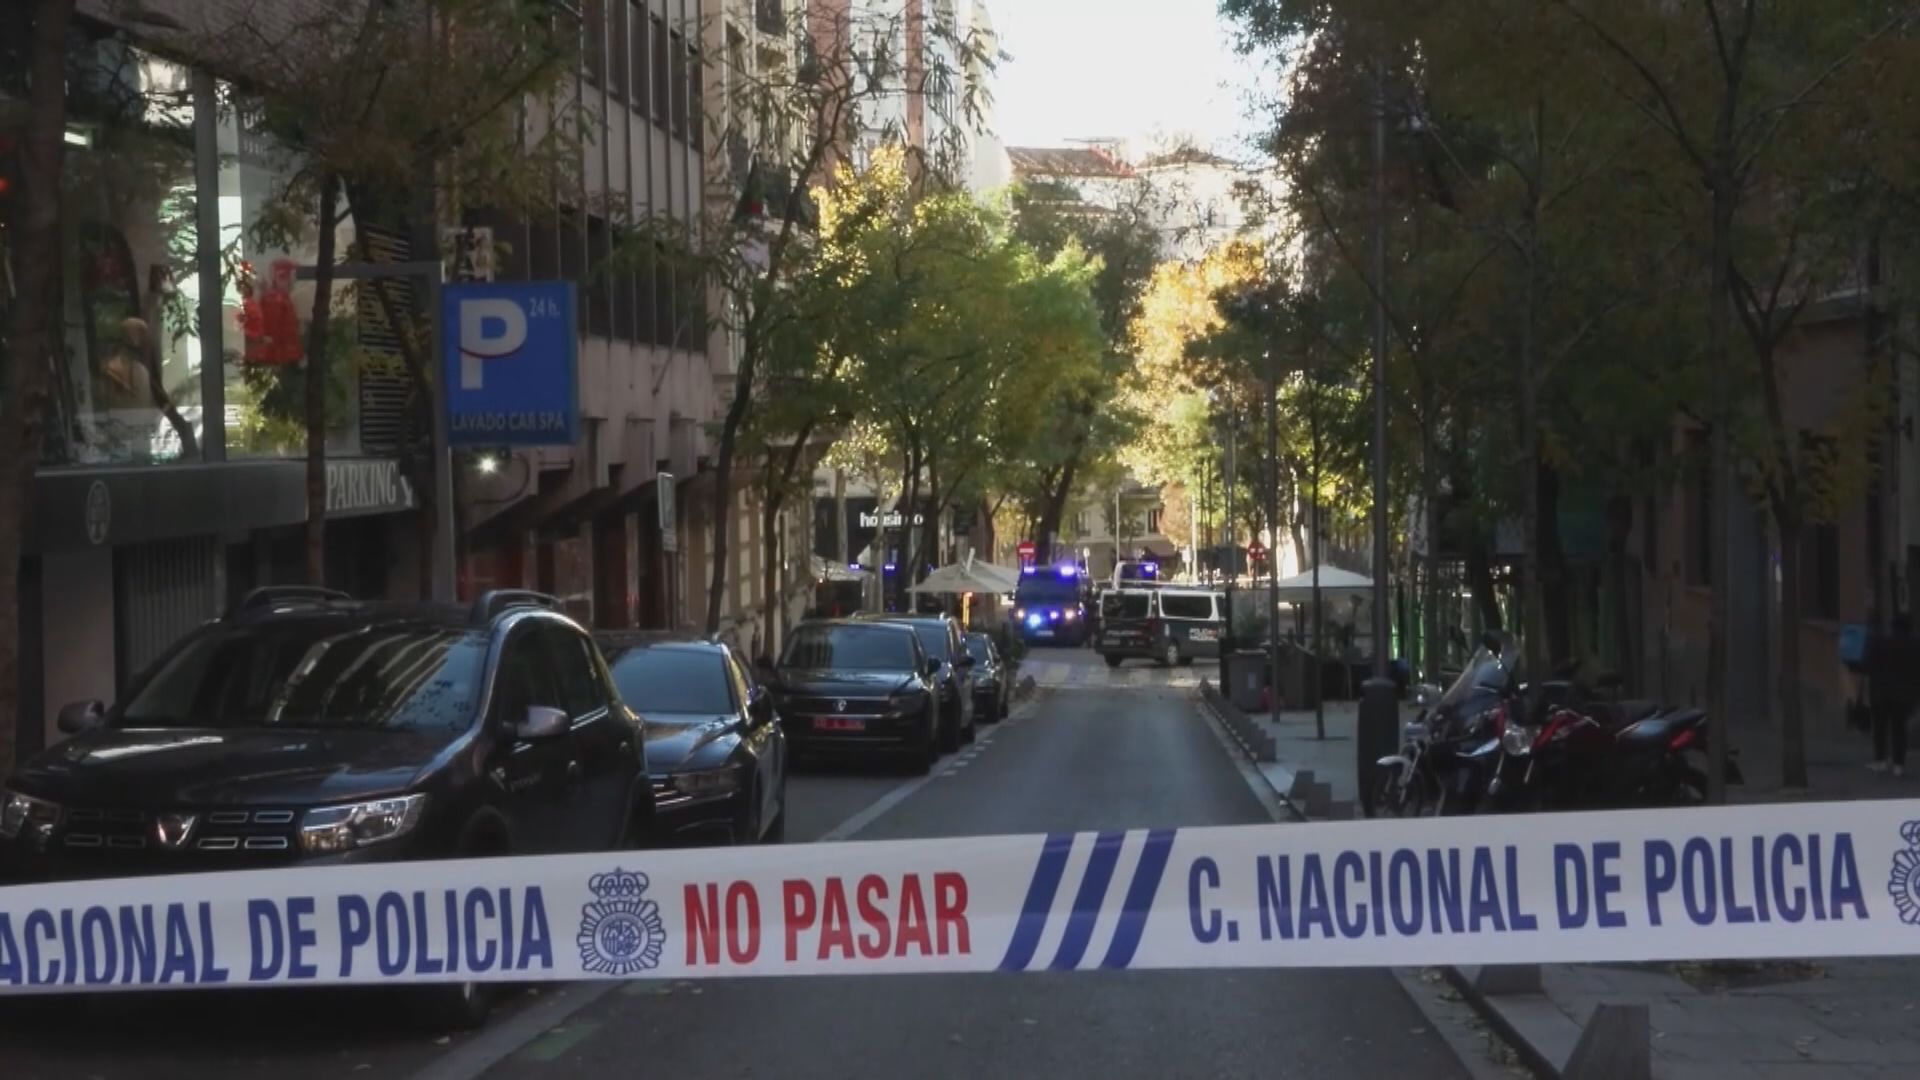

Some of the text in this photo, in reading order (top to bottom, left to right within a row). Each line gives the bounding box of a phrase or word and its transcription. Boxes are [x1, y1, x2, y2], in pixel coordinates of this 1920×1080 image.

[460, 299, 528, 389] P
[529, 297, 545, 317] 24
[451, 411, 566, 431] LAVADO CAR SPA
[325, 461, 397, 511] PARKING
[684, 872, 971, 966] NO PASAR
[1188, 832, 1870, 943] C. NACIONAL DE POLICIA
[248, 896, 317, 981] DE
[337, 886, 553, 977] POLICIA
